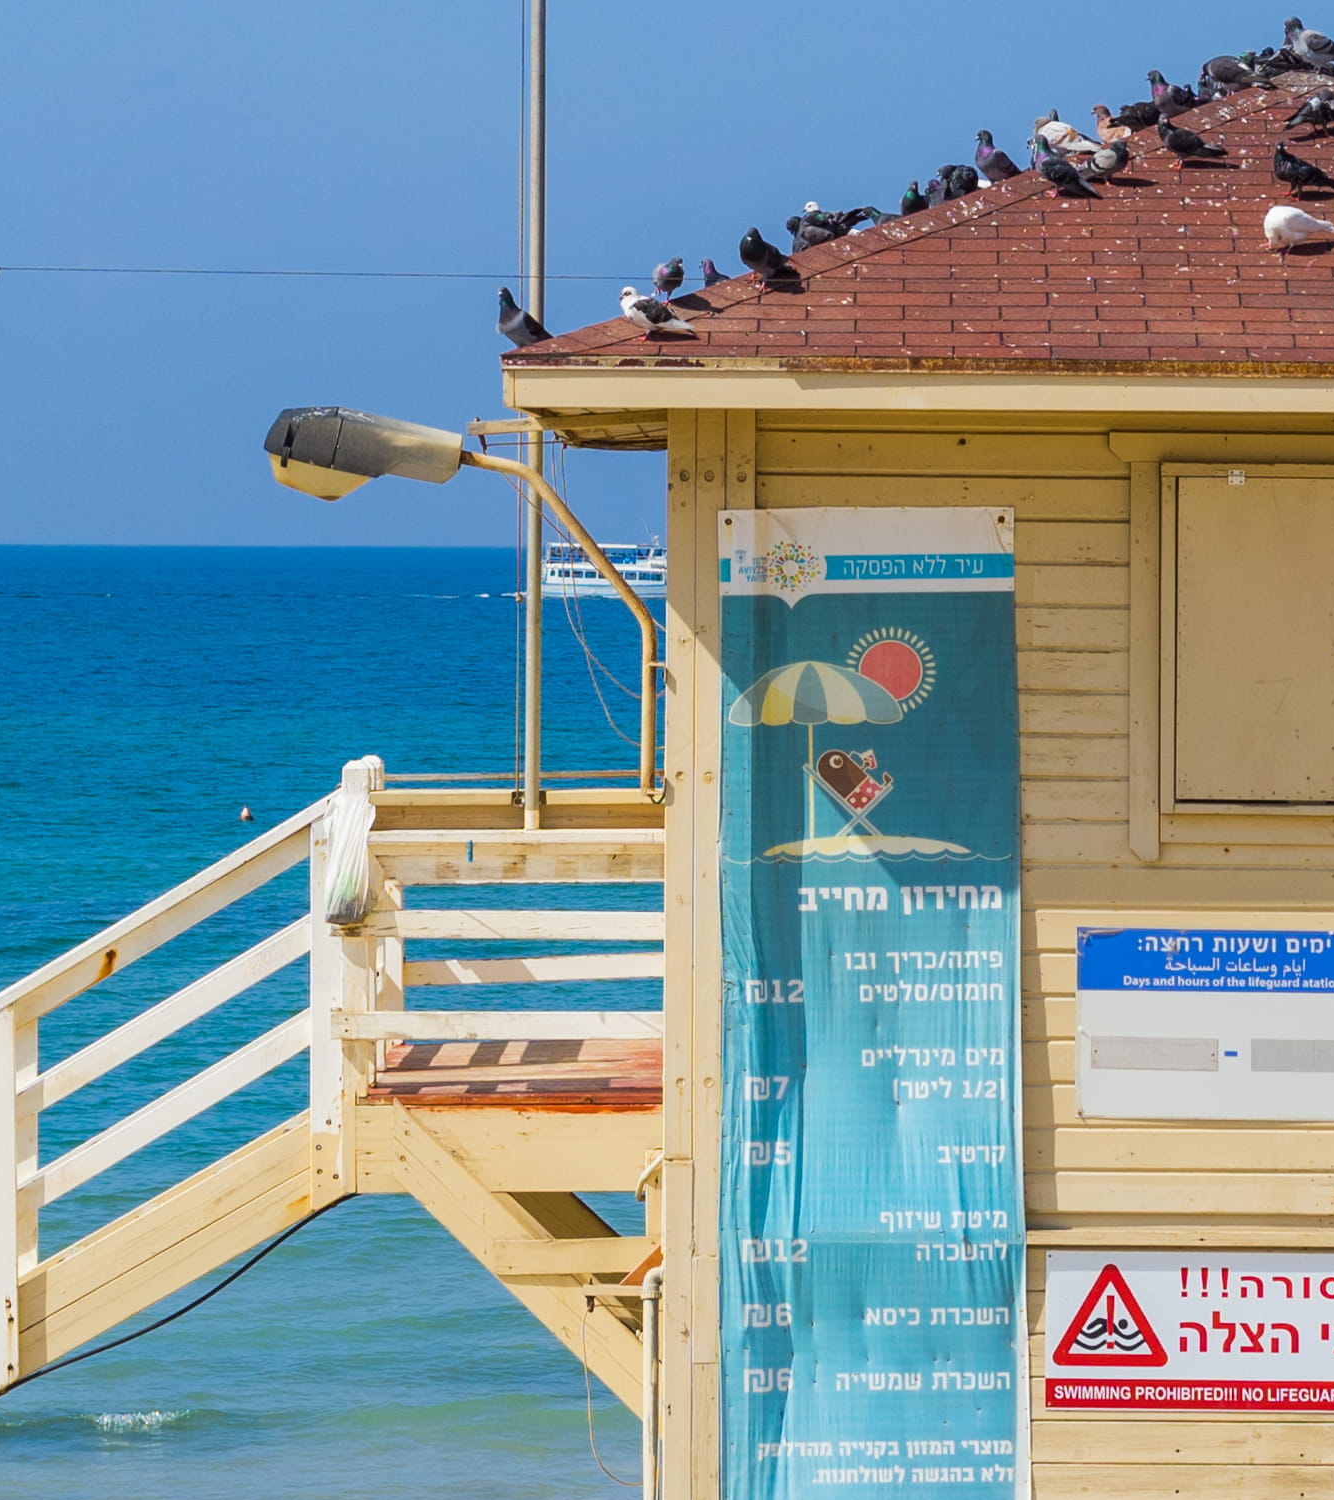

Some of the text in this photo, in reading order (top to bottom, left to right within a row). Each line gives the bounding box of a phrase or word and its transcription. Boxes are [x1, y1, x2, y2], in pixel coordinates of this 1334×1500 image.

[843, 555, 984, 580] עיר ללא הפסקה
[798, 886, 1002, 915] מחירון מחייב
[1137, 935, 1331, 955] ימים ושעות רחצה:
[845, 950, 1003, 974] פיתה/כריך ובו
[1165, 956, 1219, 975] السباحة
[1225, 957, 1277, 977] وساعات
[859, 980, 1003, 1002] חומוס/סלטים
[1123, 976, 1150, 988] Days
[1153, 976, 1175, 987] and
[1178, 976, 1210, 988] hours
[1212, 976, 1226, 988] of
[1227, 976, 1246, 988] the
[1248, 977, 1300, 990] lifeguard
[861, 1045, 1004, 1067] מים מינרליים
[937, 1145, 1005, 1168] קרטיב
[880, 1210, 1007, 1233] מיטת שיזוף
[916, 1240, 1007, 1262] להשכרה
[866, 1307, 1009, 1326] השכרת כיסא
[1179, 1310, 1300, 1353] הצלה
[836, 1371, 1010, 1392] השכרת שמשייה
[1054, 1385, 1132, 1401] SWIMMING
[1135, 1386, 1237, 1402] PROHIBITED!!!
[1242, 1387, 1264, 1402] NO
[839, 1440, 899, 1459] בקנייה
[906, 1440, 955, 1459] המזון
[961, 1439, 1013, 1455] מוצרי
[912, 1466, 975, 1483] בהגשה
